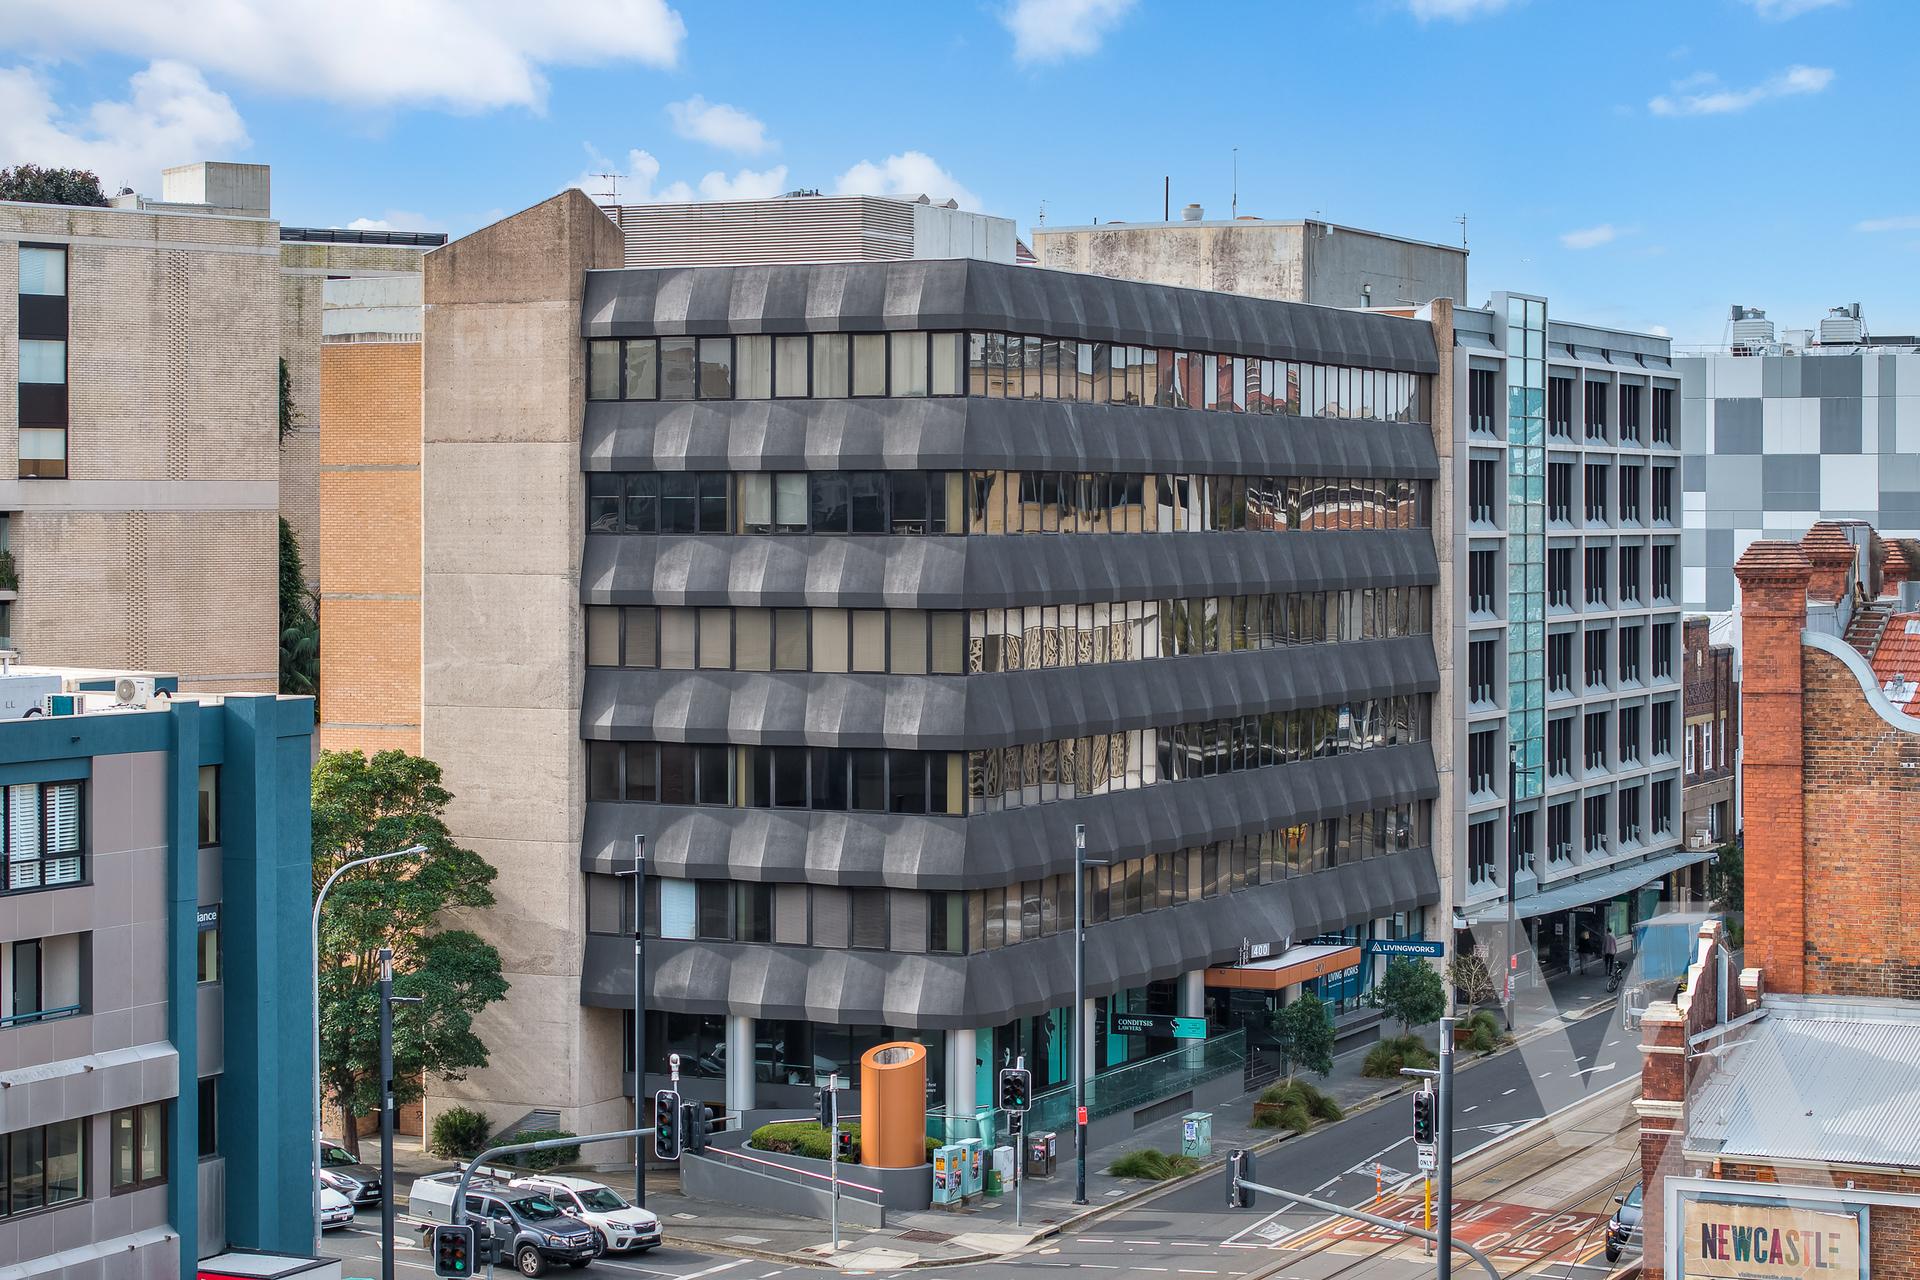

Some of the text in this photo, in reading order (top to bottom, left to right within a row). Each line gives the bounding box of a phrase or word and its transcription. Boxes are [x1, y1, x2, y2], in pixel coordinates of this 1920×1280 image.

[1253, 945, 1268, 956] 400
[1383, 944, 1435, 953] LIVINGWORKS
[1118, 1019, 1153, 1027] CONDITSIS
[1701, 1223, 1841, 1269] NEWCASTLE
